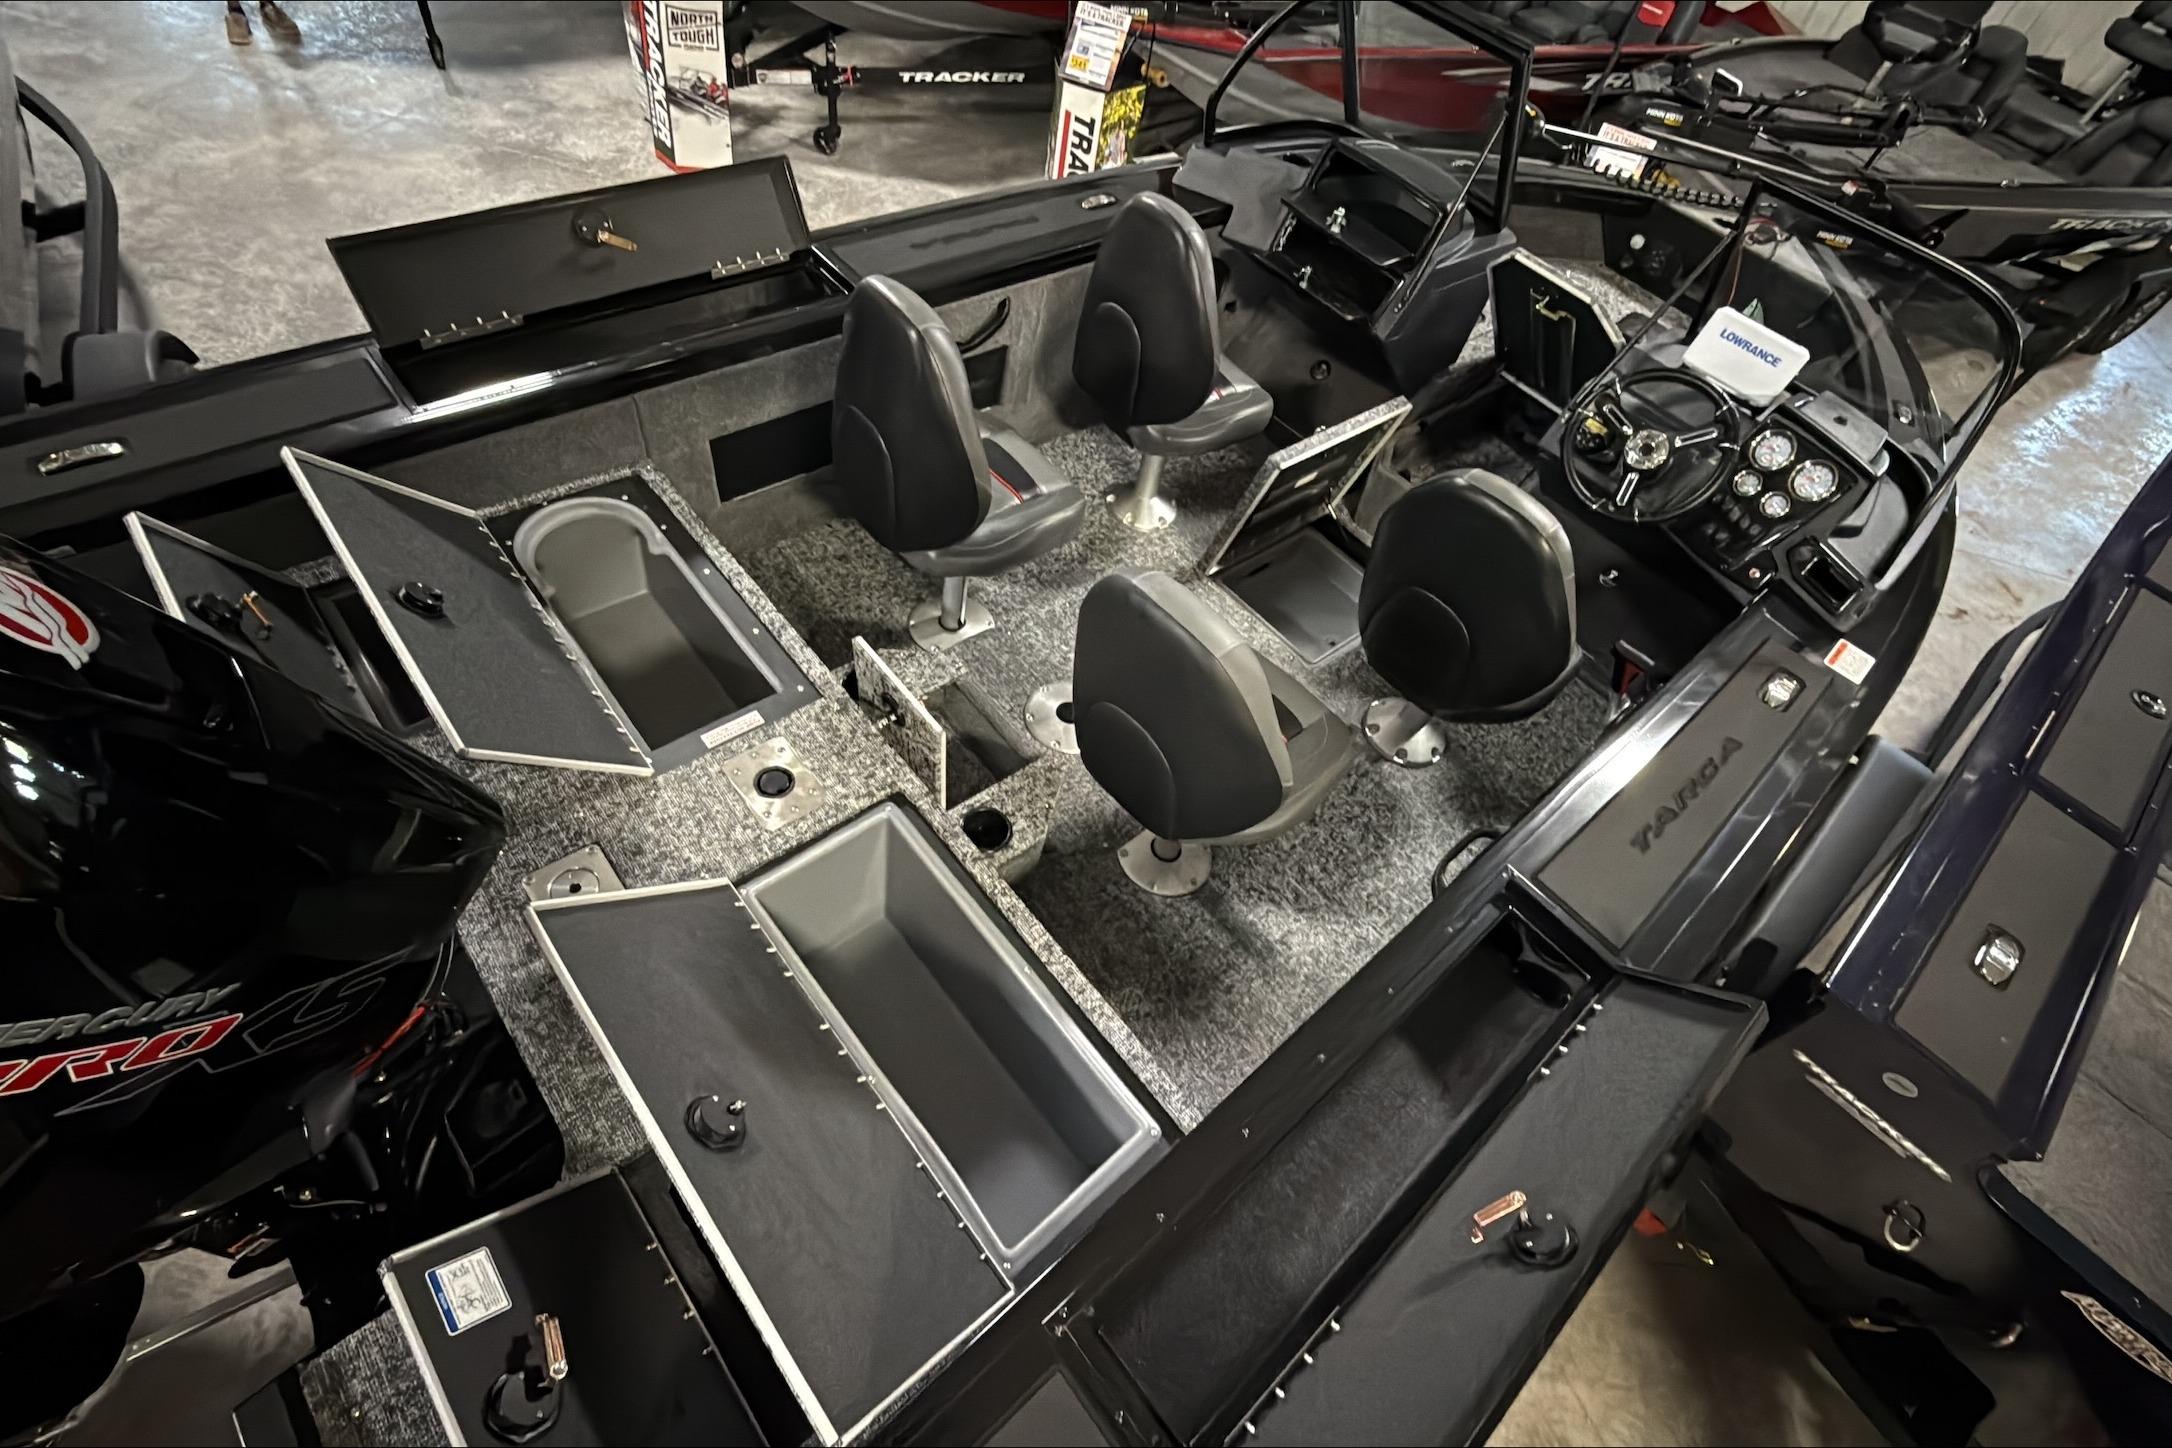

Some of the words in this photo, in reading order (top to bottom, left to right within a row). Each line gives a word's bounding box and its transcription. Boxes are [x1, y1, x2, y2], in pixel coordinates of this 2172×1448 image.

[671, 10, 713, 26] NORTH
[672, 28, 714, 45] TOUGH
[643, 1, 672, 148] TRACKER
[899, 71, 1025, 83] TRACKER
[1067, 115, 1096, 177] TRA
[1720, 328, 1782, 368] LOWRANCE
[1629, 736, 1743, 854] TARGA
[0, 1013, 243, 1096] RO
